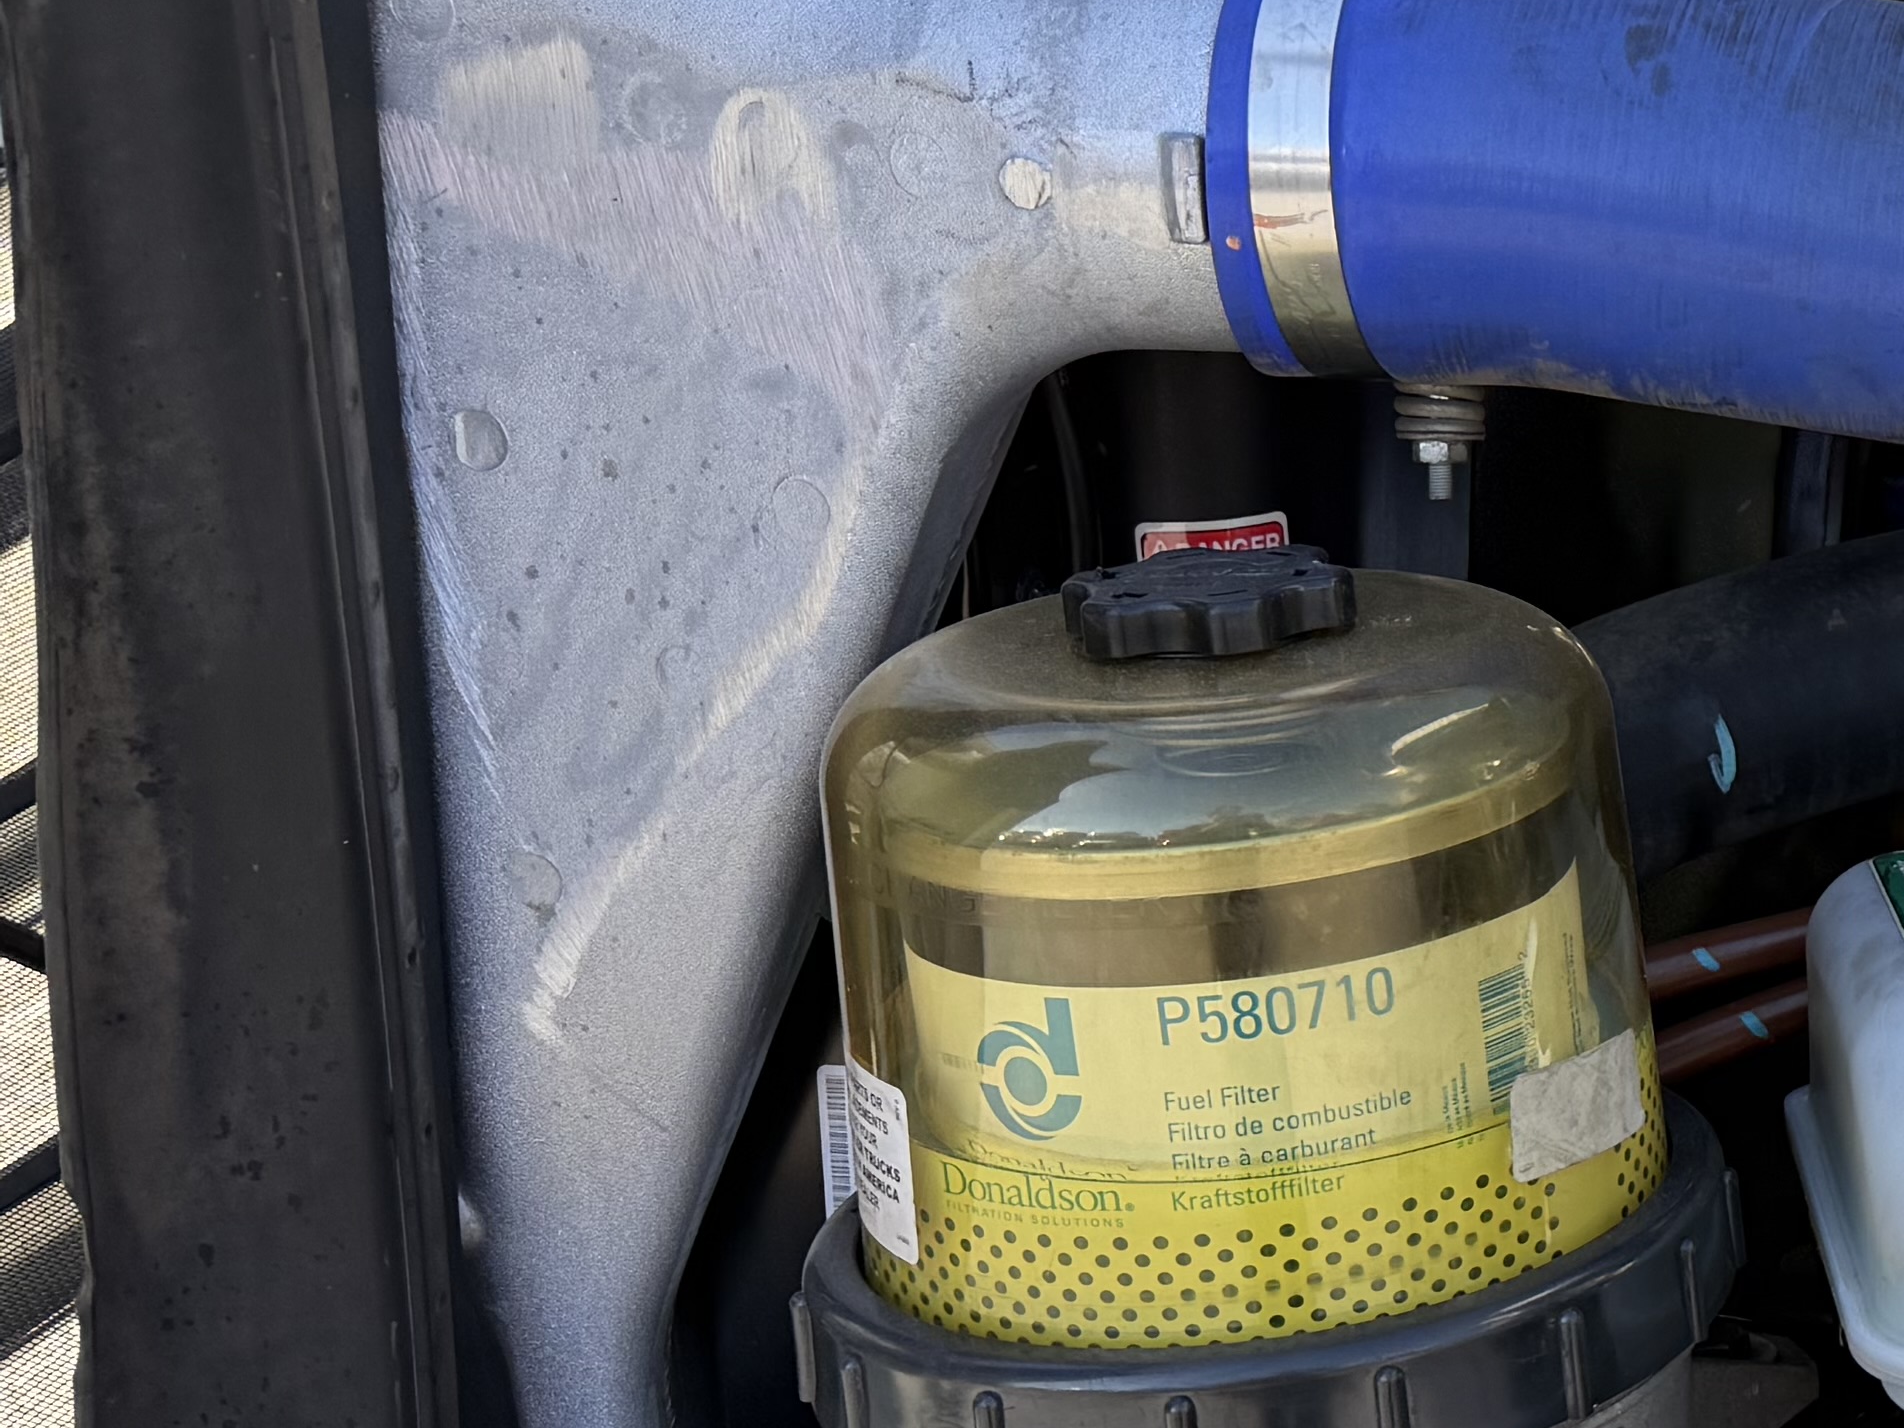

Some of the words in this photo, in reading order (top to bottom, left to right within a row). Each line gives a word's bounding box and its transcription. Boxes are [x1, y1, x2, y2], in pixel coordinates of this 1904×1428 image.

[1156, 966, 1395, 1046] P580710
[1164, 1089, 1212, 1112] Fuel
[1220, 1084, 1280, 1107] Filter
[1168, 1122, 1227, 1143] Filtro
[1235, 1116, 1263, 1138] de
[1272, 1088, 1412, 1132] combustible
[864, 1150, 901, 1183] TRUCKS
[1172, 1152, 1230, 1172] Filtre
[1239, 1148, 1251, 1166] à
[1261, 1128, 1378, 1162] carburant
[1171, 1174, 1345, 1212] Kraftstofffilter
[946, 1200, 1023, 1223] FILTRATION
[1031, 1214, 1124, 1228] SOLUTIONS
